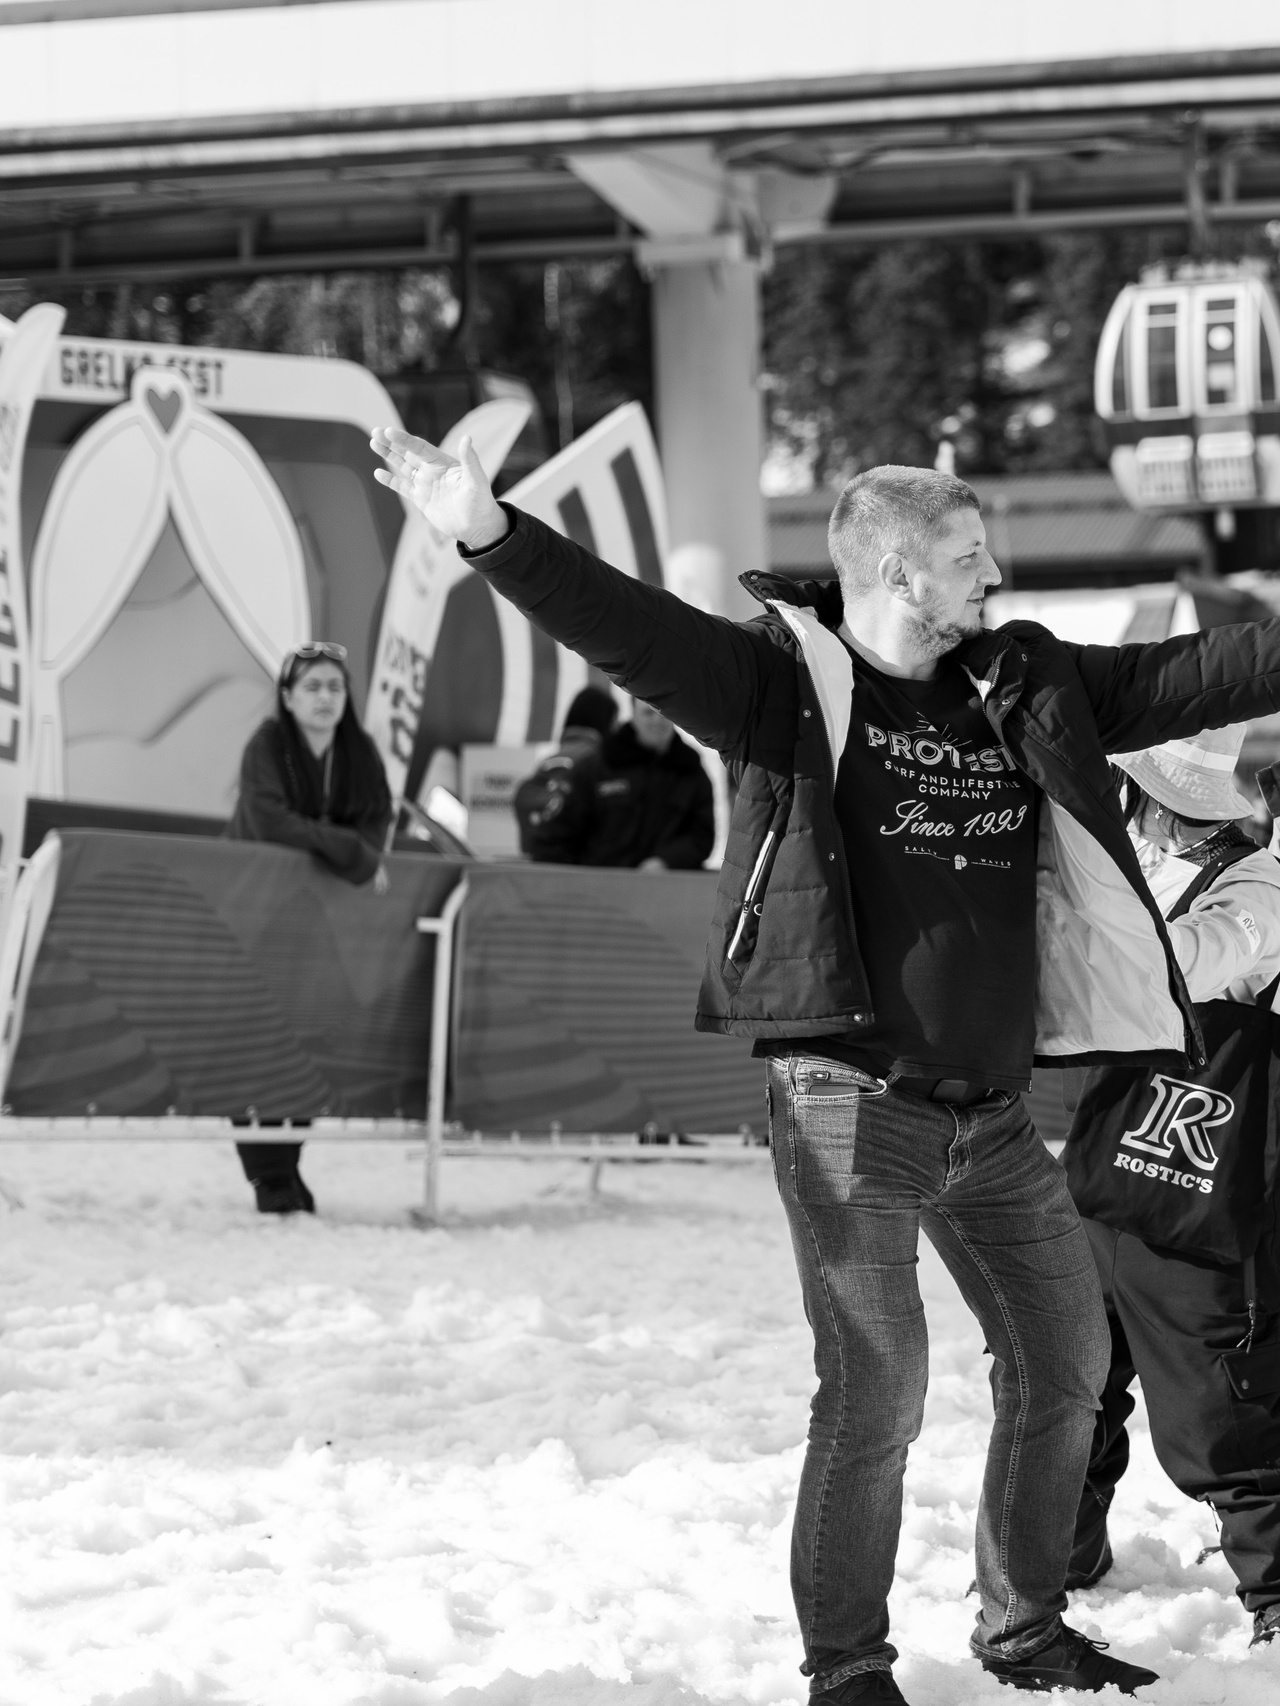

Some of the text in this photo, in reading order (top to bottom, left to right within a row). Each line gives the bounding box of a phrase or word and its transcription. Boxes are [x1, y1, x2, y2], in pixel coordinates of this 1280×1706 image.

[918, 784, 991, 800] COMPANY
[919, 773, 949, 786] AND
[953, 778, 1020, 789] LIFESTYLE
[879, 799, 1028, 837] Since 1993
[1119, 1073, 1235, 1171] R
[1113, 1152, 1214, 1194] ROSTIC'S
